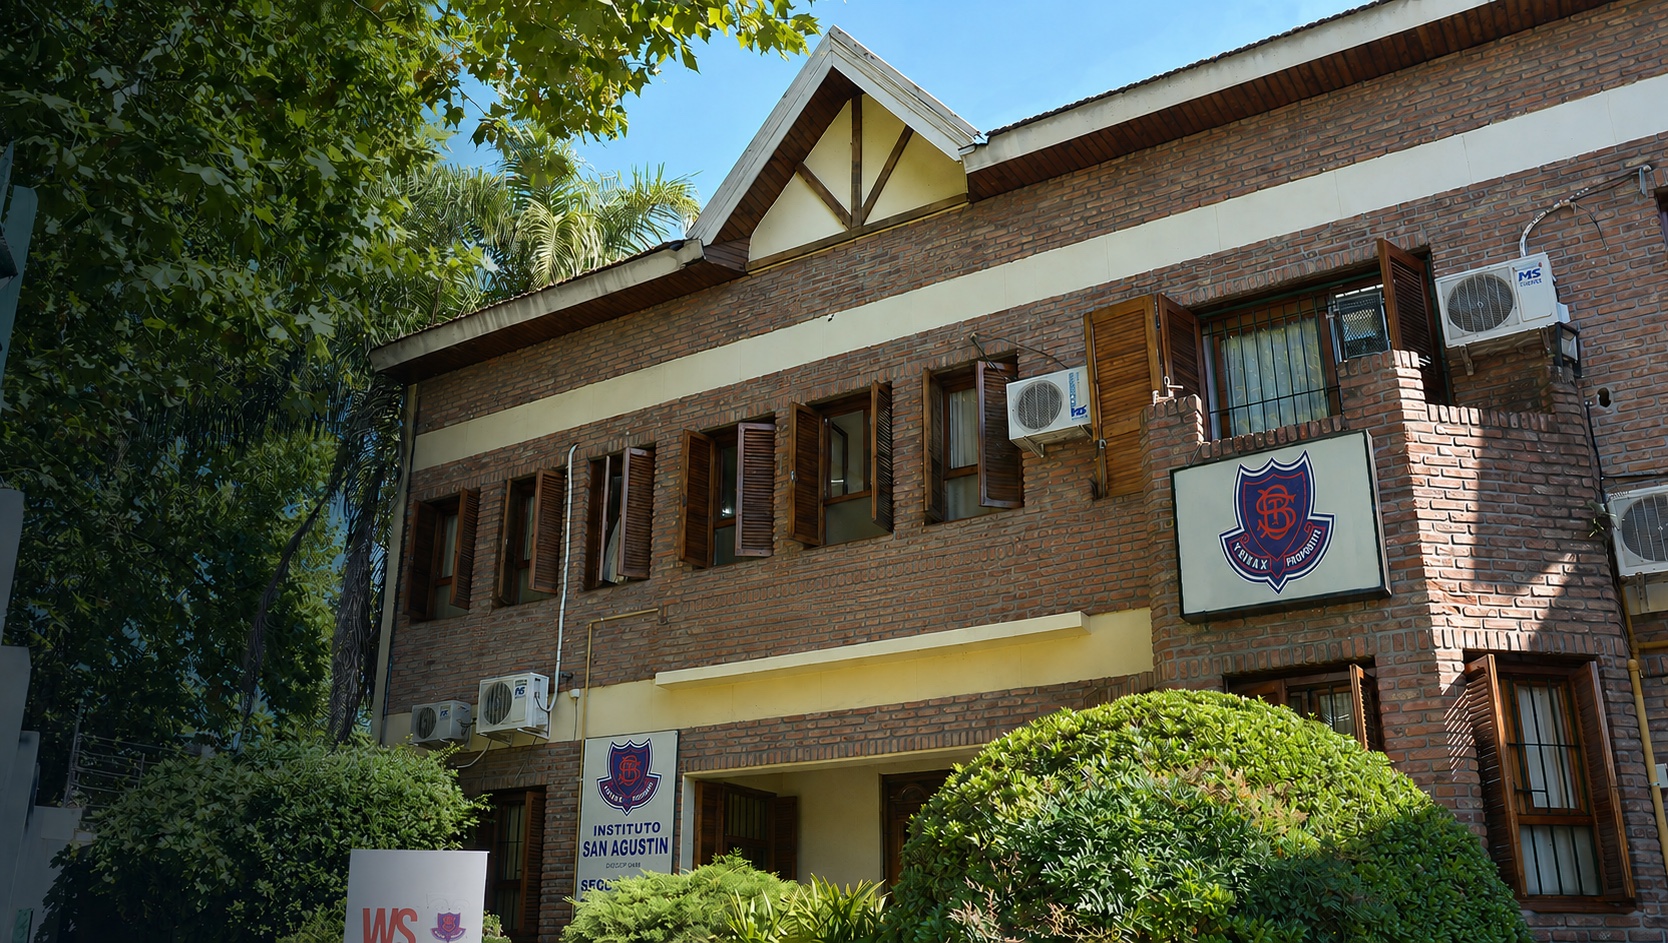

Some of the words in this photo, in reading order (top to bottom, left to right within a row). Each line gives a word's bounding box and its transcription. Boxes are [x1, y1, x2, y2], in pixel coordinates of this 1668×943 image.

[1518, 268, 1541, 282] MS
[593, 821, 661, 836] INSTITUTO
[582, 839, 608, 858] SAN
[611, 837, 669, 857] AGUSTIN
